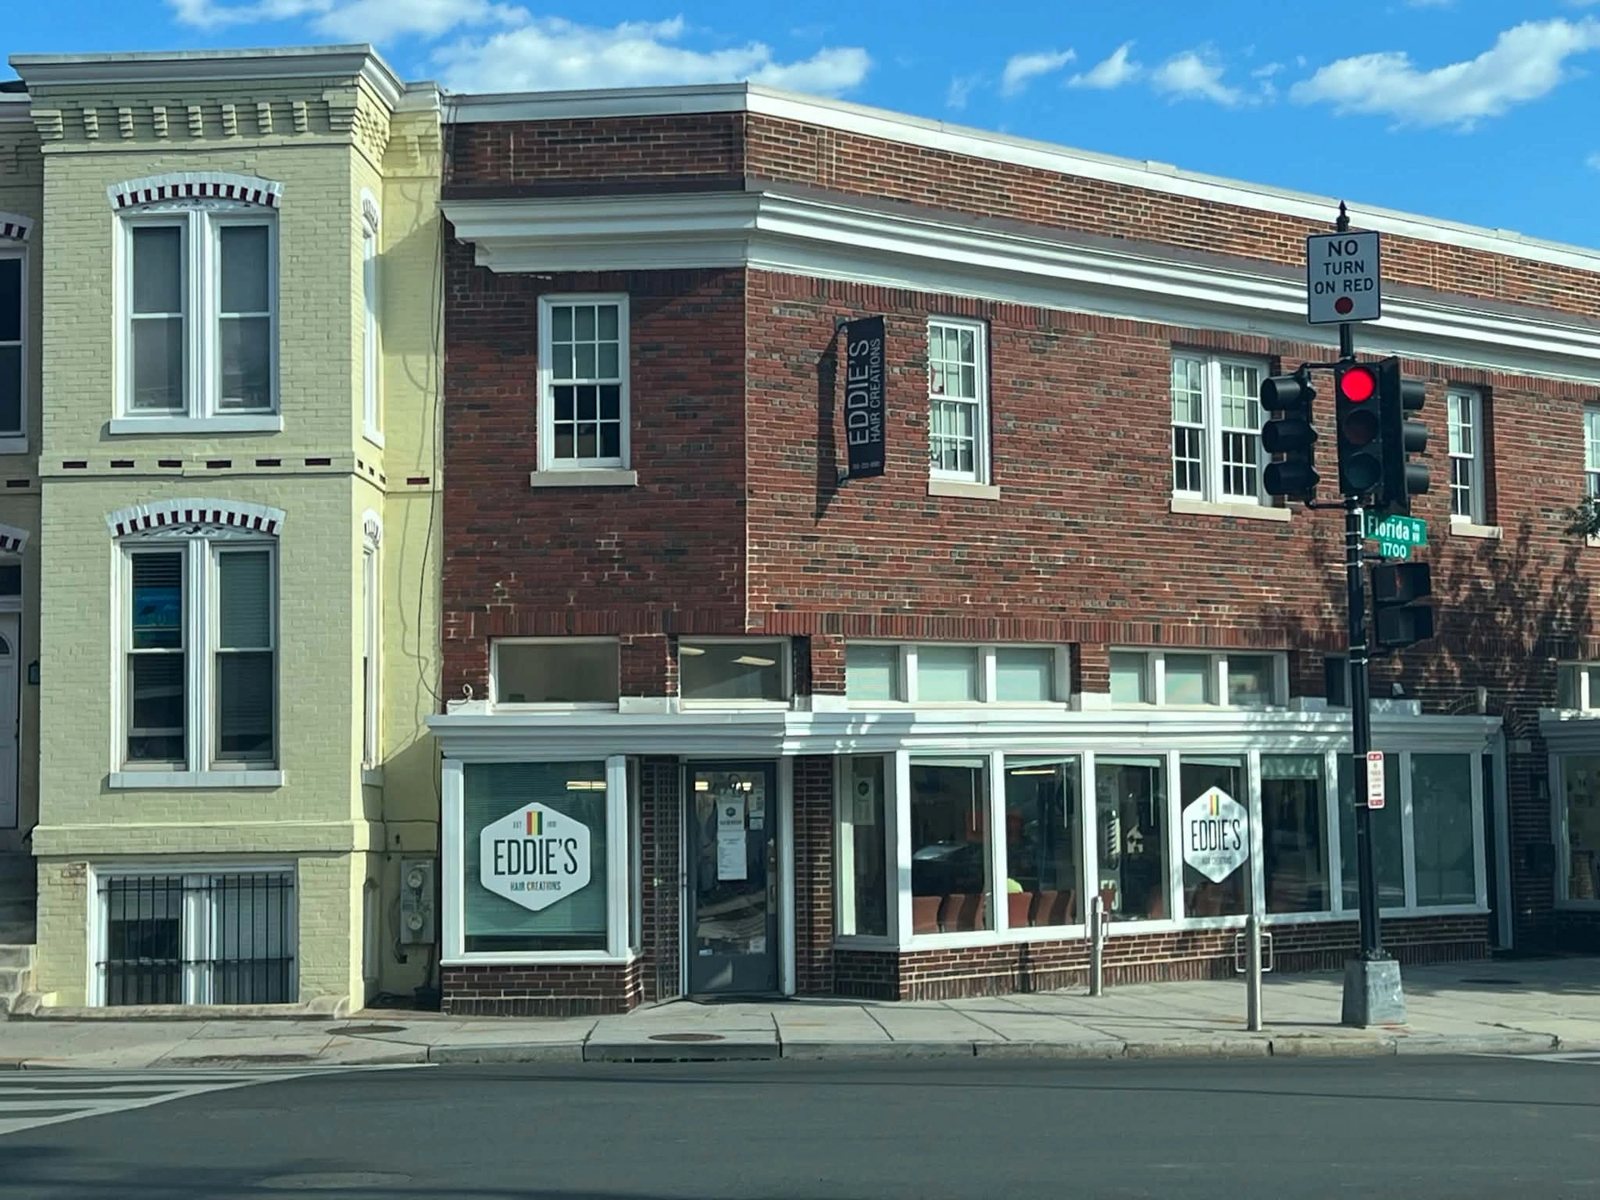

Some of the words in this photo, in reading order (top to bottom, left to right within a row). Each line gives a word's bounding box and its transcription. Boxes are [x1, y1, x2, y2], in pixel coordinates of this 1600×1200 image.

[1328, 240, 1358, 257] NO
[1323, 260, 1364, 276] TURN
[1314, 281, 1335, 295] ON
[1343, 278, 1374, 293] RED
[870, 338, 881, 409] CREATIONS
[848, 339, 870, 446] EDDIE'S
[870, 412, 881, 443] HAIR
[1368, 516, 1410, 541] Florida
[1382, 542, 1407, 559] 1700
[1191, 819, 1242, 852] EDDIE'S
[494, 838, 578, 876] EDDIE'S
[510, 881, 525, 891] HAIR
[527, 881, 561, 891] CREATIONS
